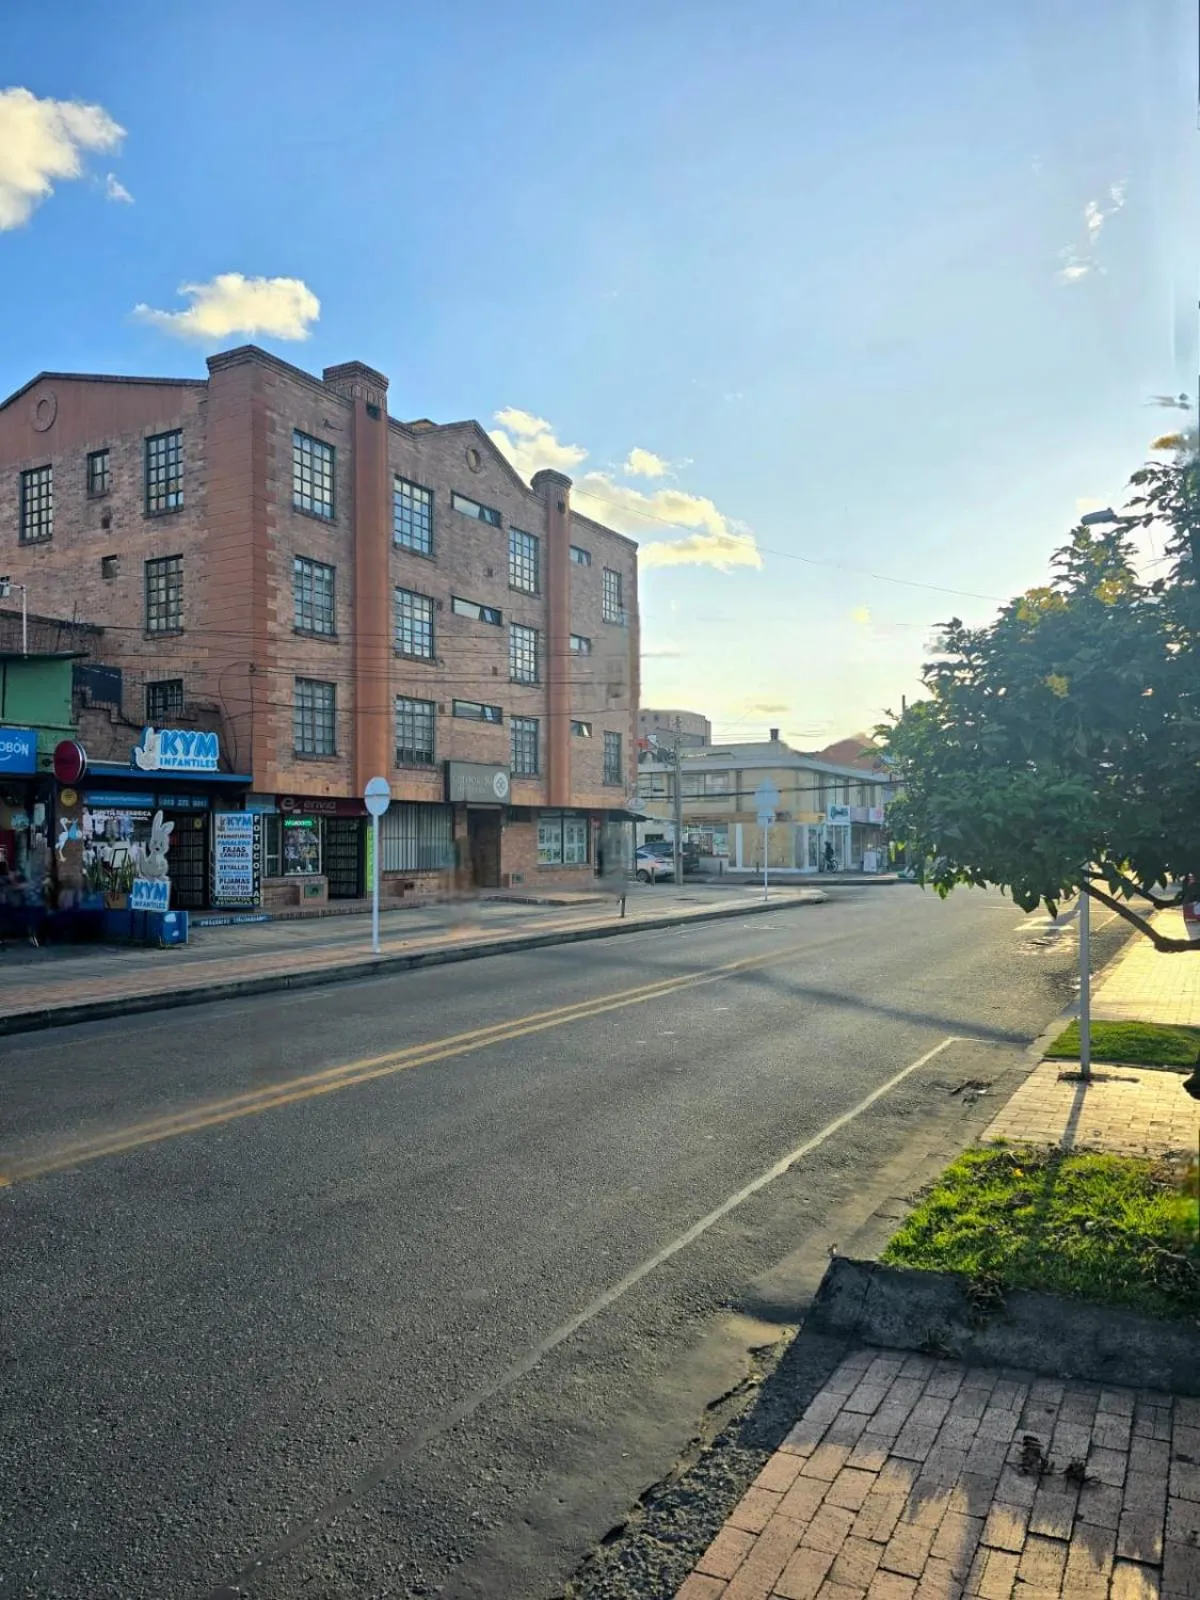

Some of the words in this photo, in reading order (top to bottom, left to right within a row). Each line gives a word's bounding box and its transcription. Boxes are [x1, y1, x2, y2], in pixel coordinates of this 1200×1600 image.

[160, 730, 217, 757] KYM
[160, 757, 216, 769] INFANTILES
[226, 815, 252, 827] KYM
[253, 815, 261, 905] FOTOCOPIAS
[134, 881, 168, 900] KYM
